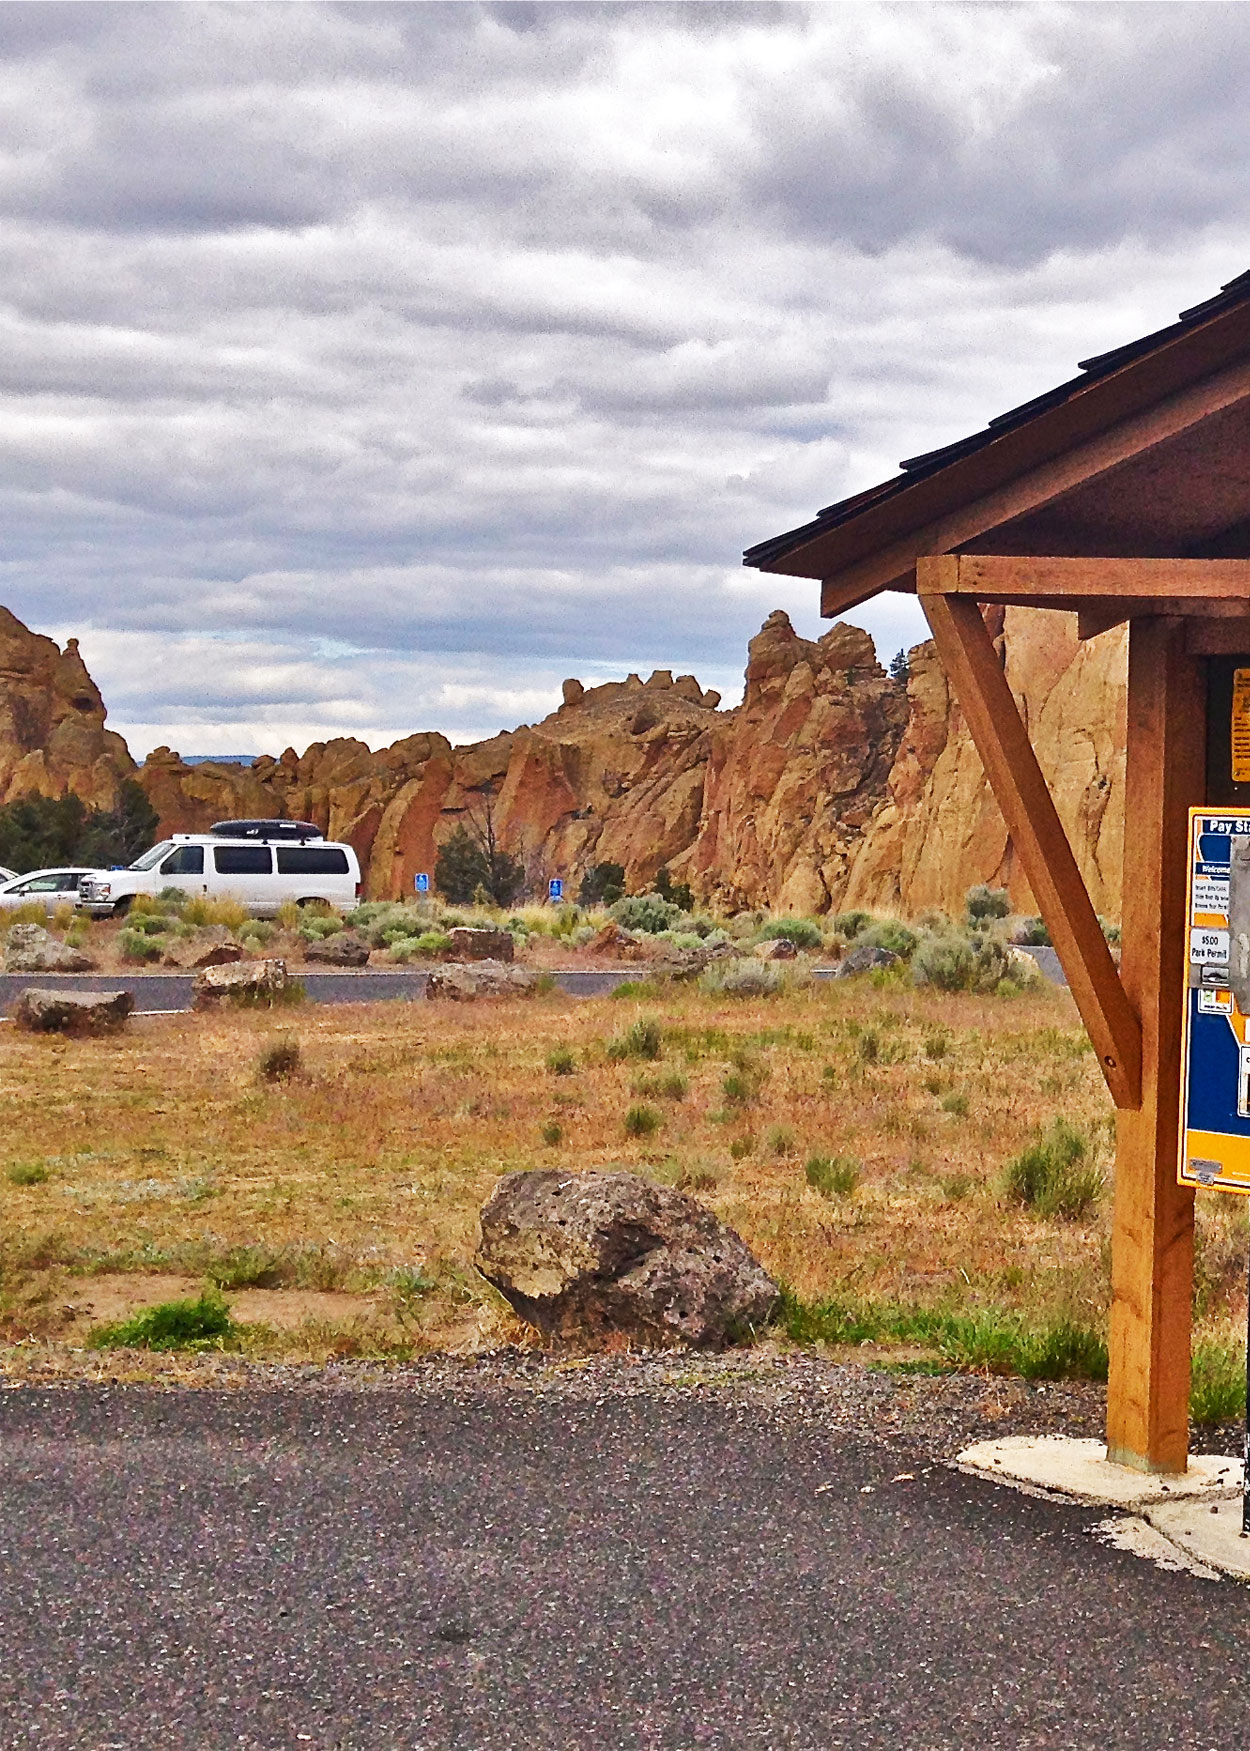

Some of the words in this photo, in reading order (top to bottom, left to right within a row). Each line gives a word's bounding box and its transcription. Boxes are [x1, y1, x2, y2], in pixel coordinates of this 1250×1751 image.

[1209, 820, 1232, 834] Pay
[1192, 948, 1205, 957] Park
[1207, 949, 1227, 959] Permit
